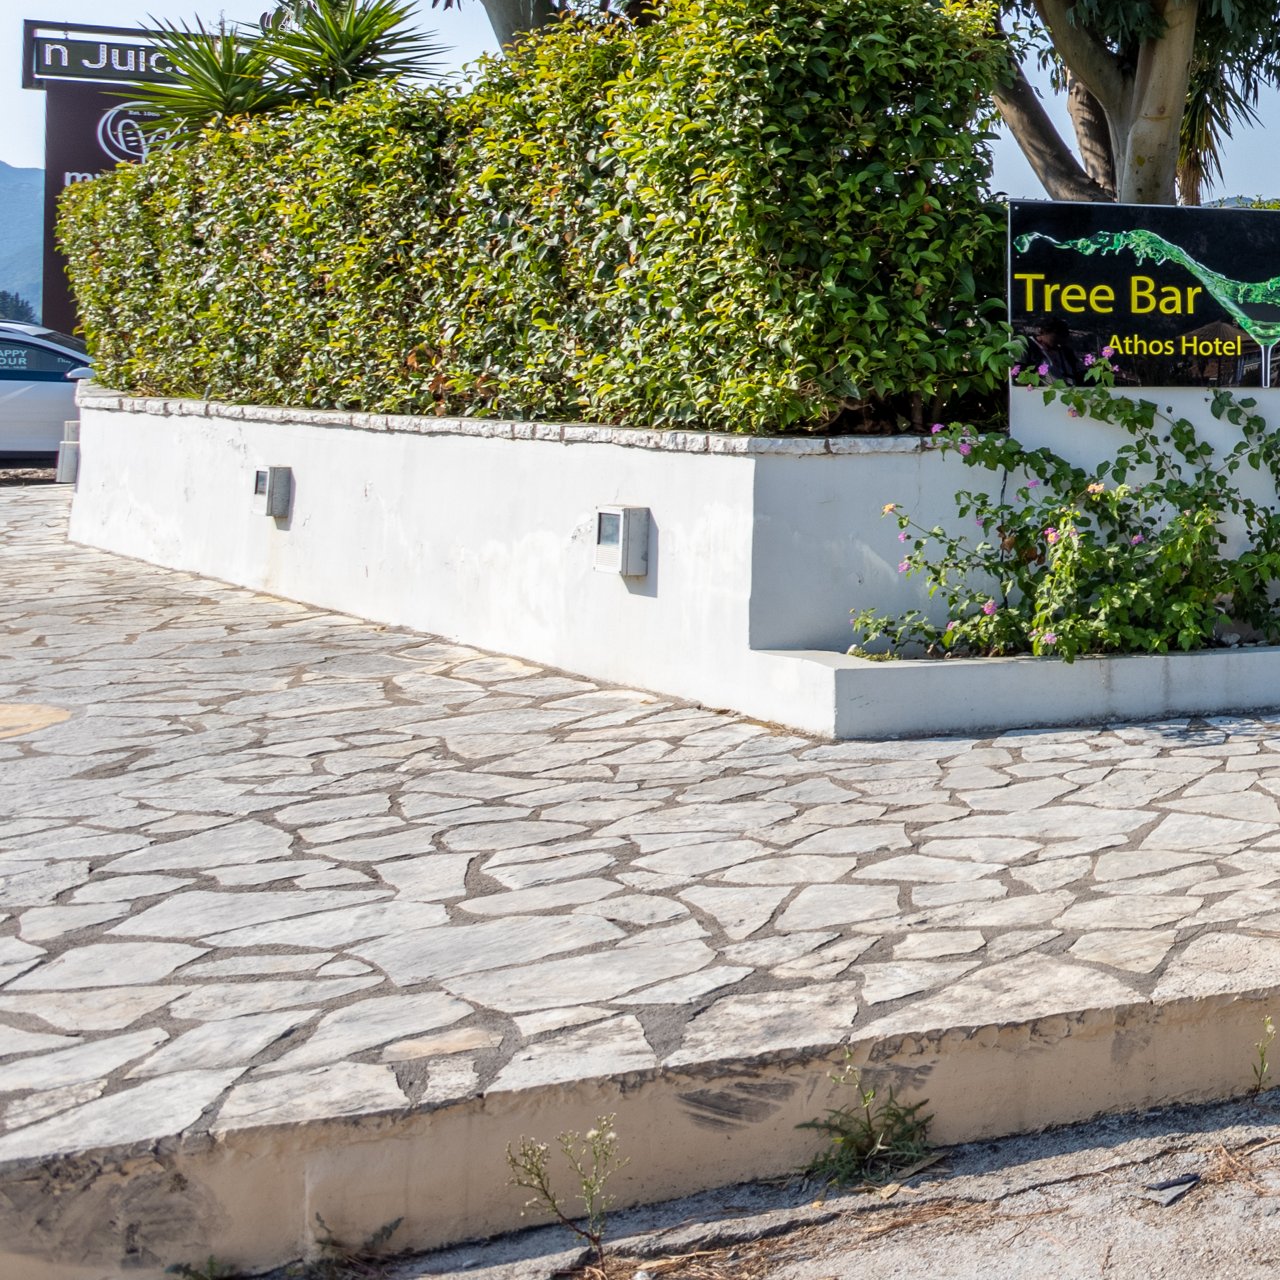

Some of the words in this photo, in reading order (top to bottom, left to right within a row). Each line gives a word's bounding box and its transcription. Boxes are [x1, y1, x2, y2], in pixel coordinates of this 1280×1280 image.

[81, 43, 190, 76] Juic
[1014, 273, 1115, 313] Tree
[1131, 275, 1202, 314] Bar
[1109, 334, 1175, 356] Athos
[1181, 335, 1242, 356] Hotel
